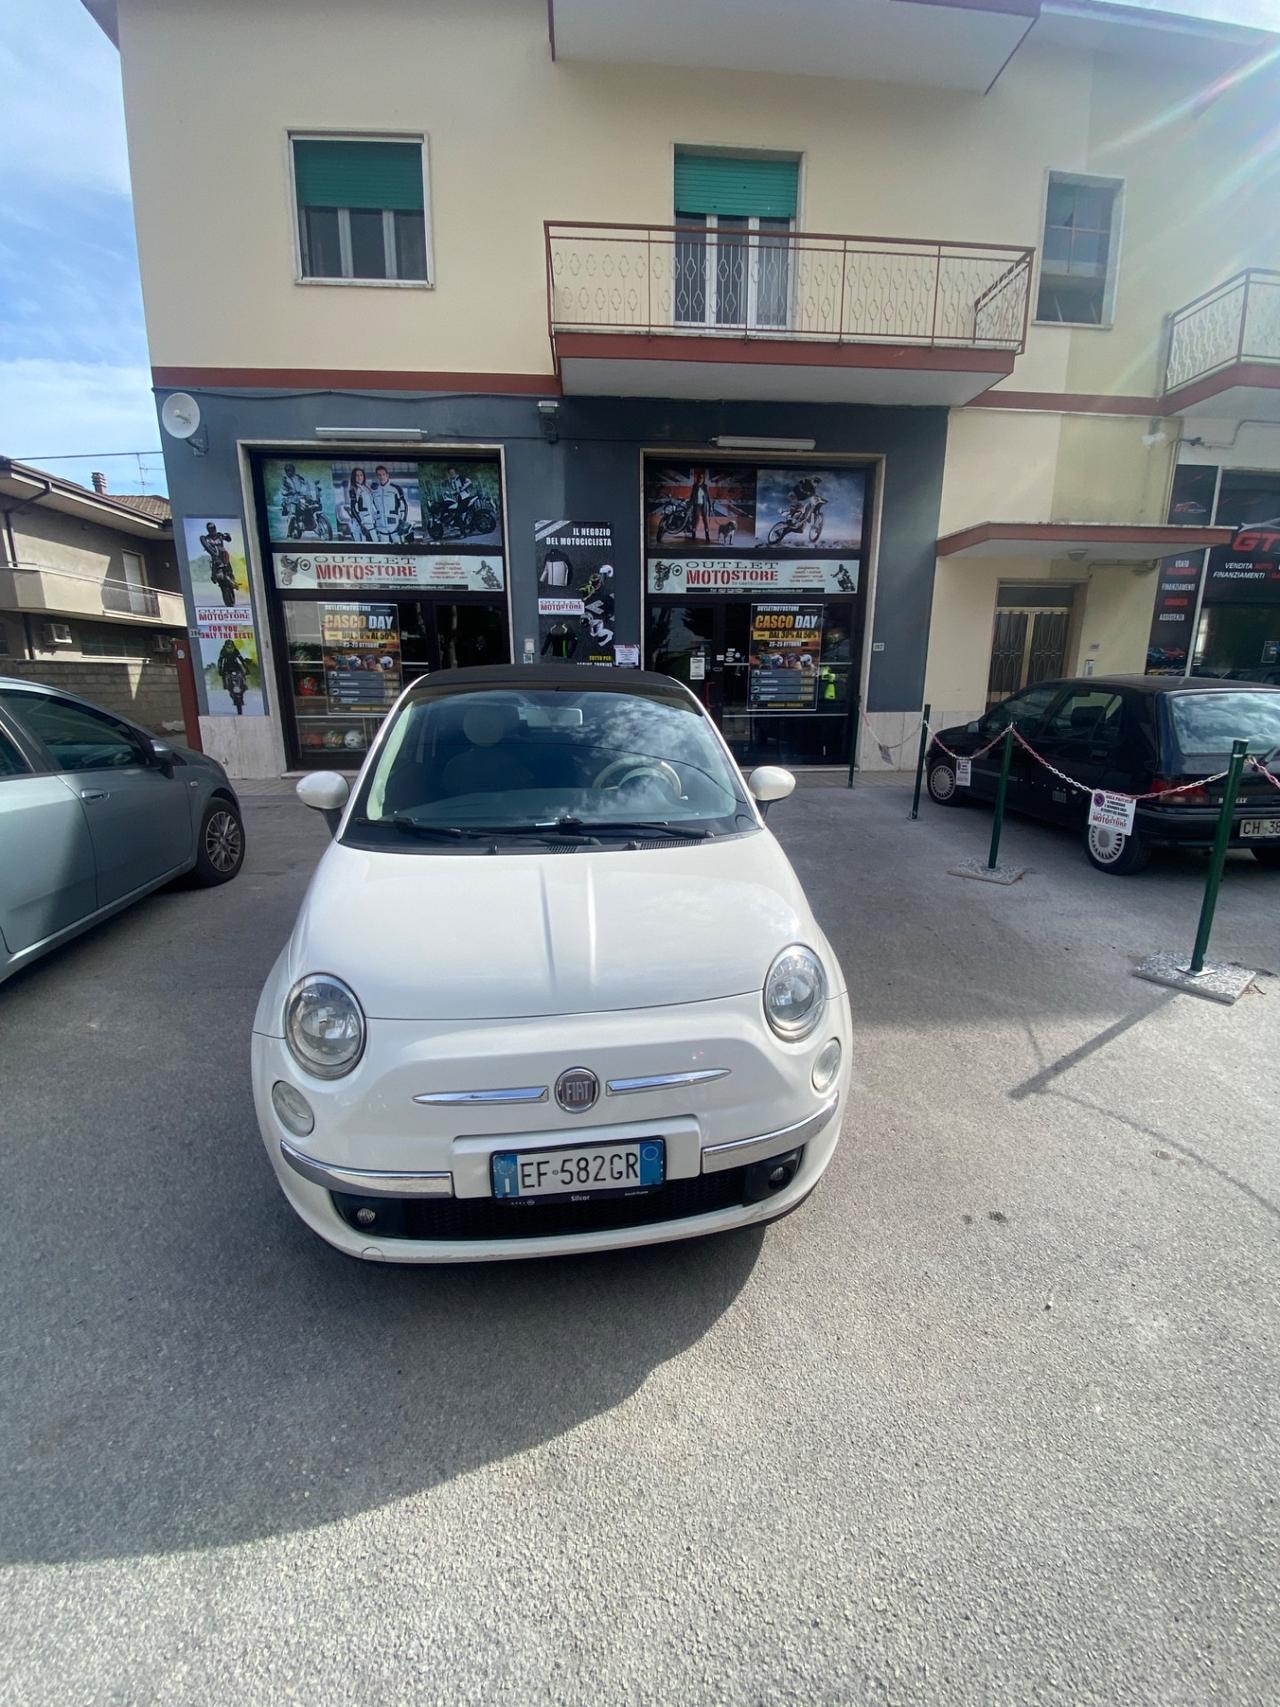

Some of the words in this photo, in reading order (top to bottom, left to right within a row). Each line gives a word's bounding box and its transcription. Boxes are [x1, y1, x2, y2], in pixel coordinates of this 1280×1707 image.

[573, 528, 580, 536] IL
[581, 528, 611, 536] NEGOZIO
[546, 537, 559, 545] DEL
[560, 538, 612, 546] MOTOCICLISTA
[1232, 532, 1280, 552] GT
[313, 556, 416, 565] OUTLET
[686, 561, 778, 569] OUTLET
[1224, 562, 1254, 570] VENDITA
[315, 564, 417, 580] MOTOSTORE
[686, 570, 778, 585] MOTOSTORE
[1212, 571, 1265, 579] FINANZIAMENTI
[325, 614, 367, 629] CASCO
[368, 615, 393, 630] DAY
[755, 615, 794, 629] CASCO
[794, 615, 818, 629] DAY
[1243, 821, 1261, 835] CH
[565, 1081, 592, 1101] FIAT
